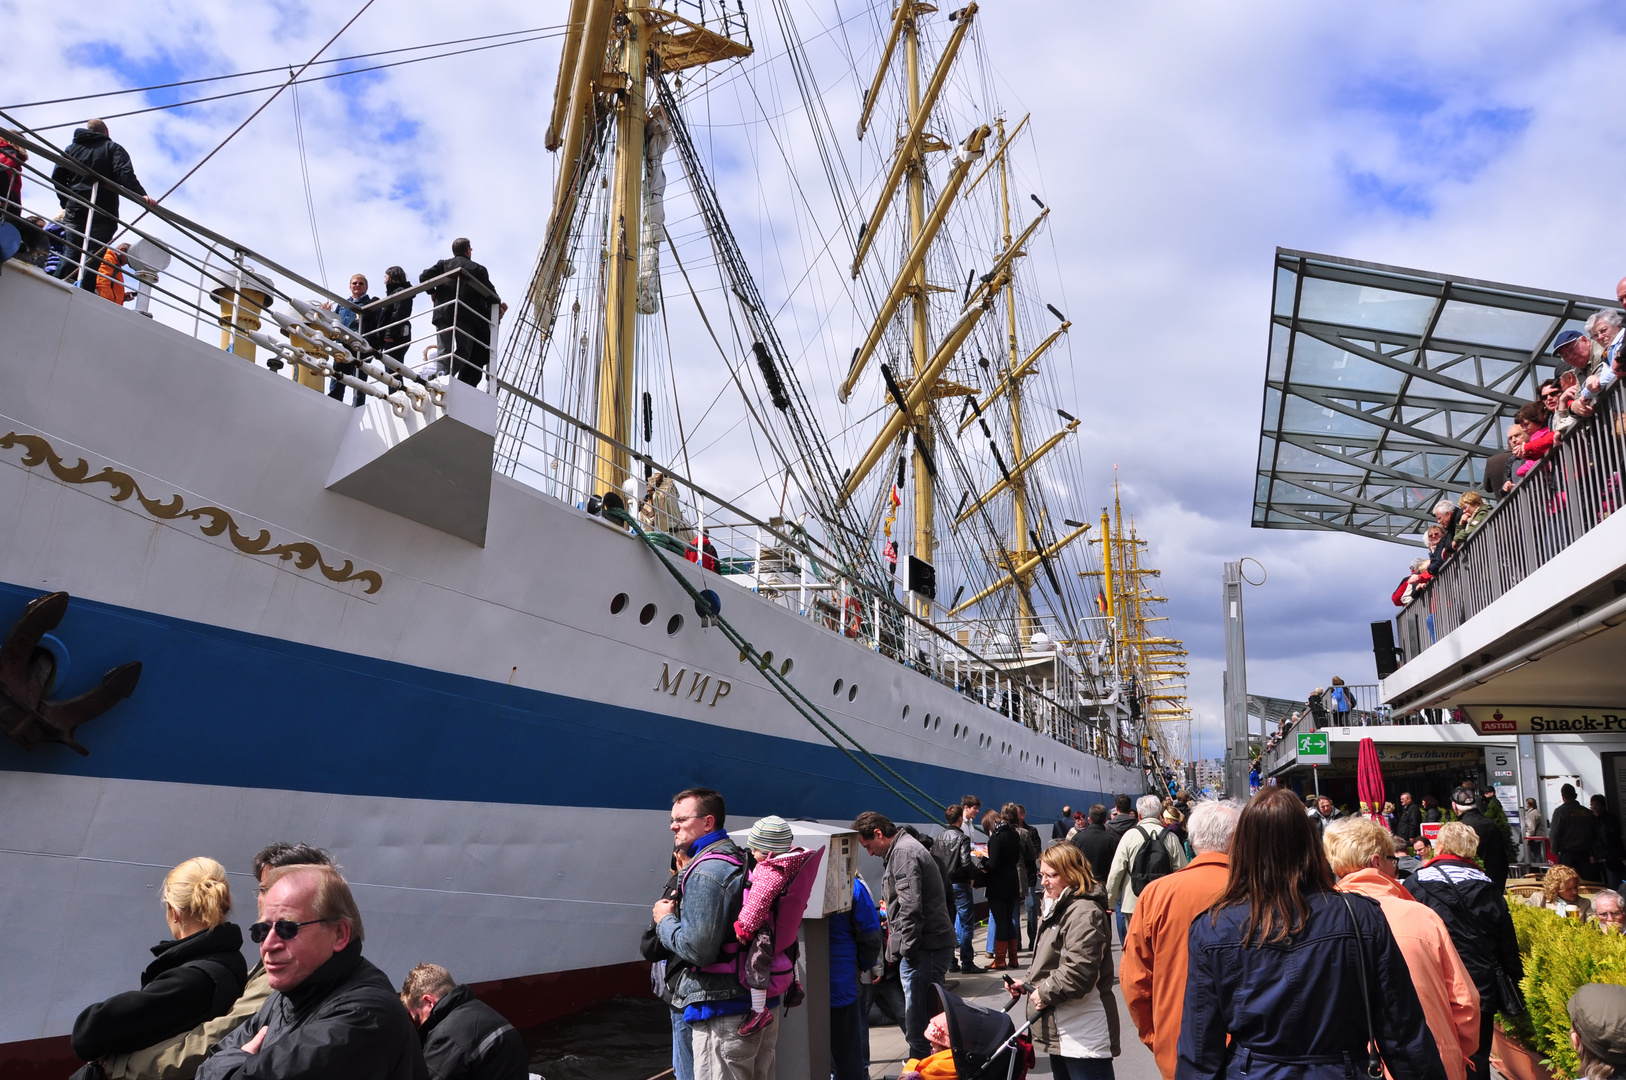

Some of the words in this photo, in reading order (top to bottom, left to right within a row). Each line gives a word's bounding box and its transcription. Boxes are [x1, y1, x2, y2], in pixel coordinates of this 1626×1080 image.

[652, 661, 732, 707] МИР
[1483, 722, 1515, 730] ASTRA
[1495, 755, 1508, 766] 5
